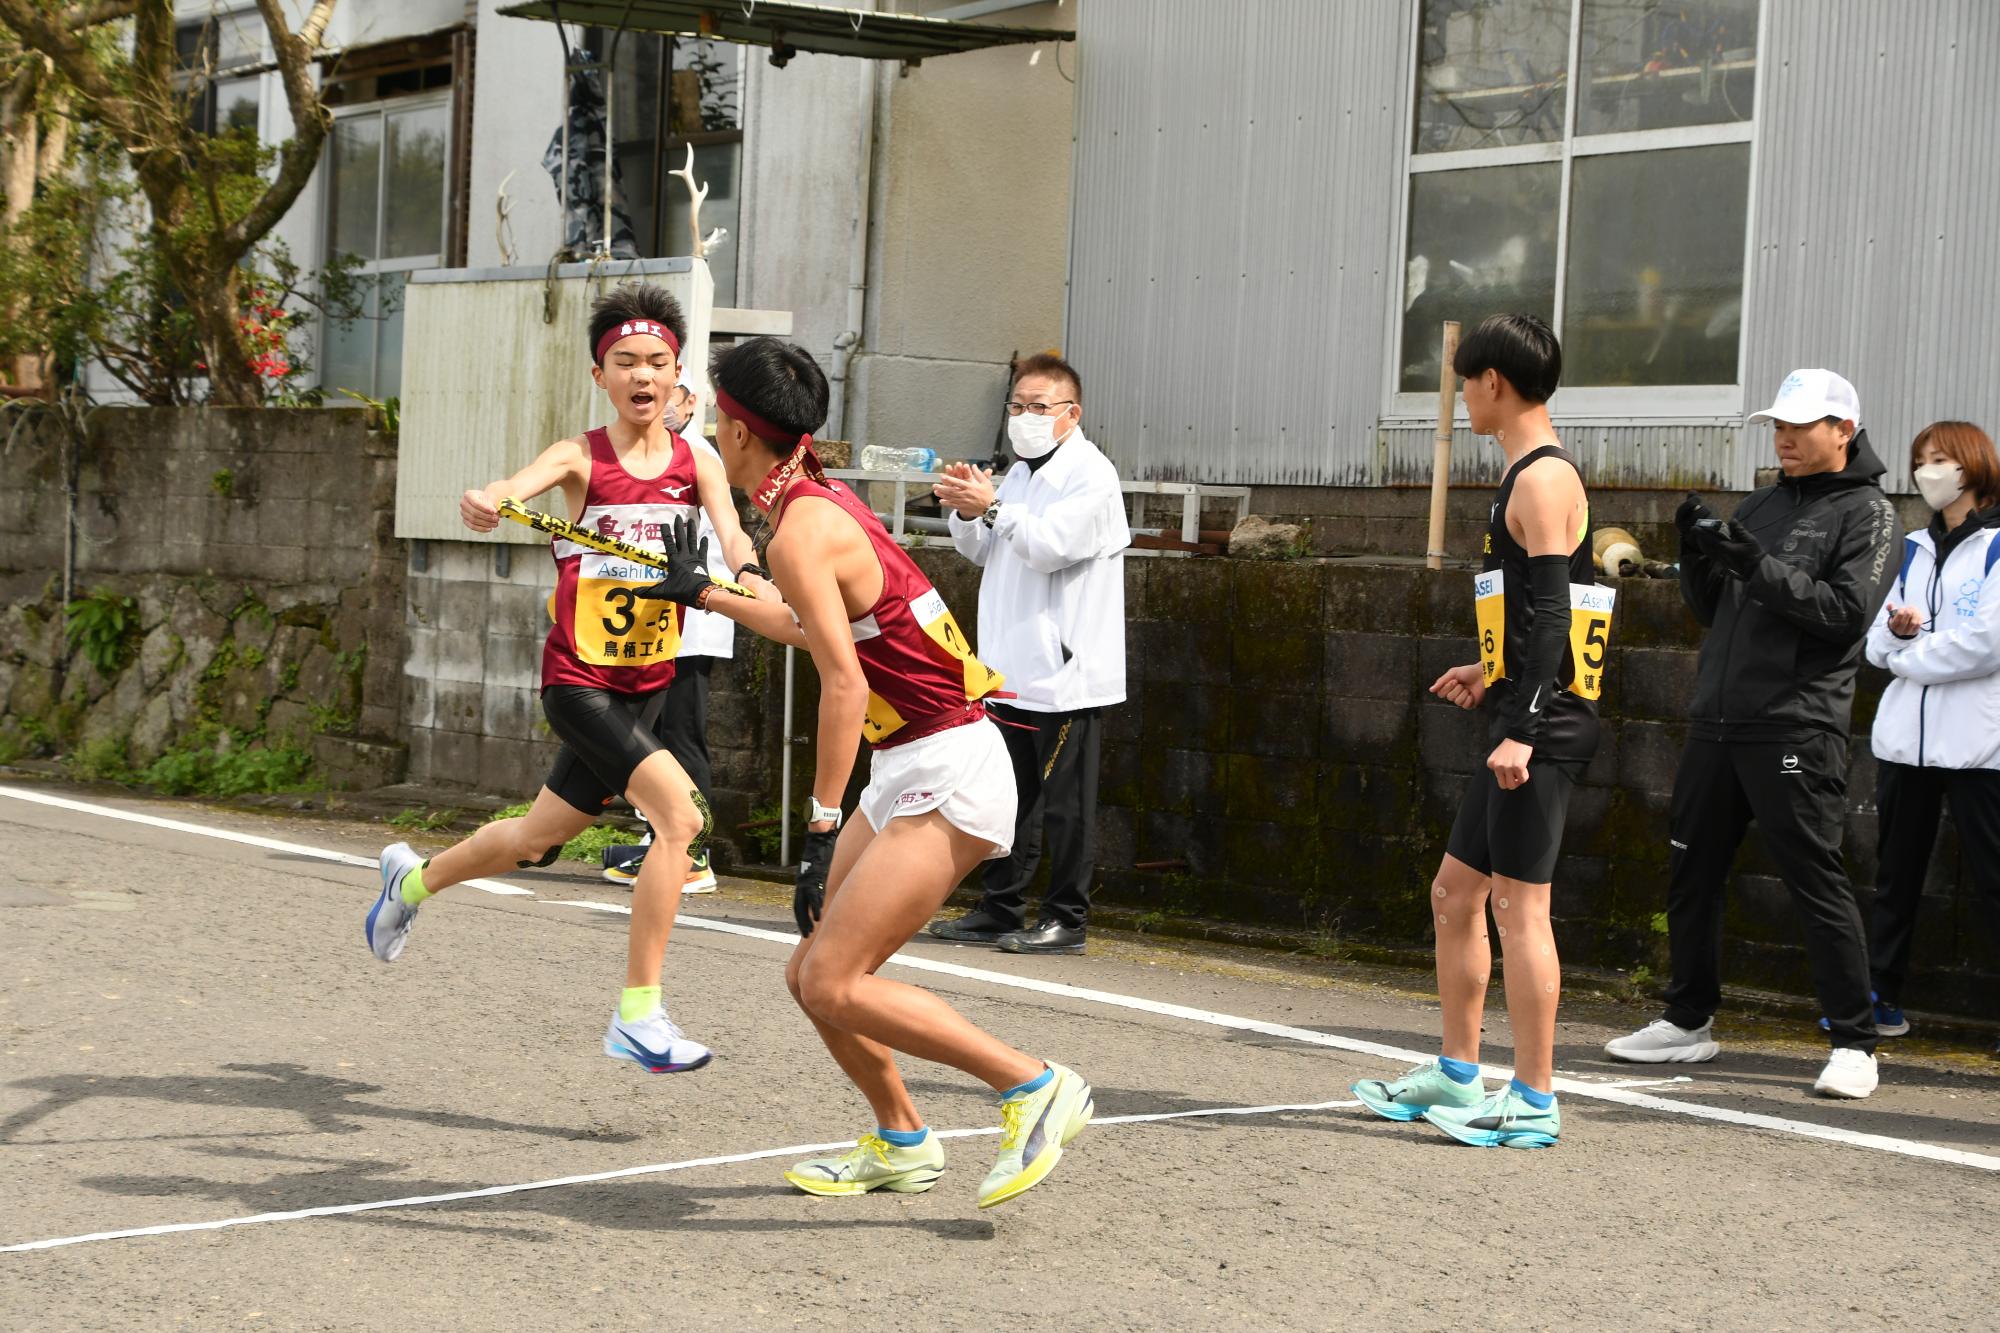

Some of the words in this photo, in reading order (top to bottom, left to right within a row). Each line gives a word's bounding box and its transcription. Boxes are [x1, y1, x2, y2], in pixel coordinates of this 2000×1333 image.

[596, 514, 688, 544] 鳥栖
[598, 562, 667, 579] AsahiKA
[603, 637, 664, 659] 鳥栖工業
[1583, 618, 1606, 670] 5
